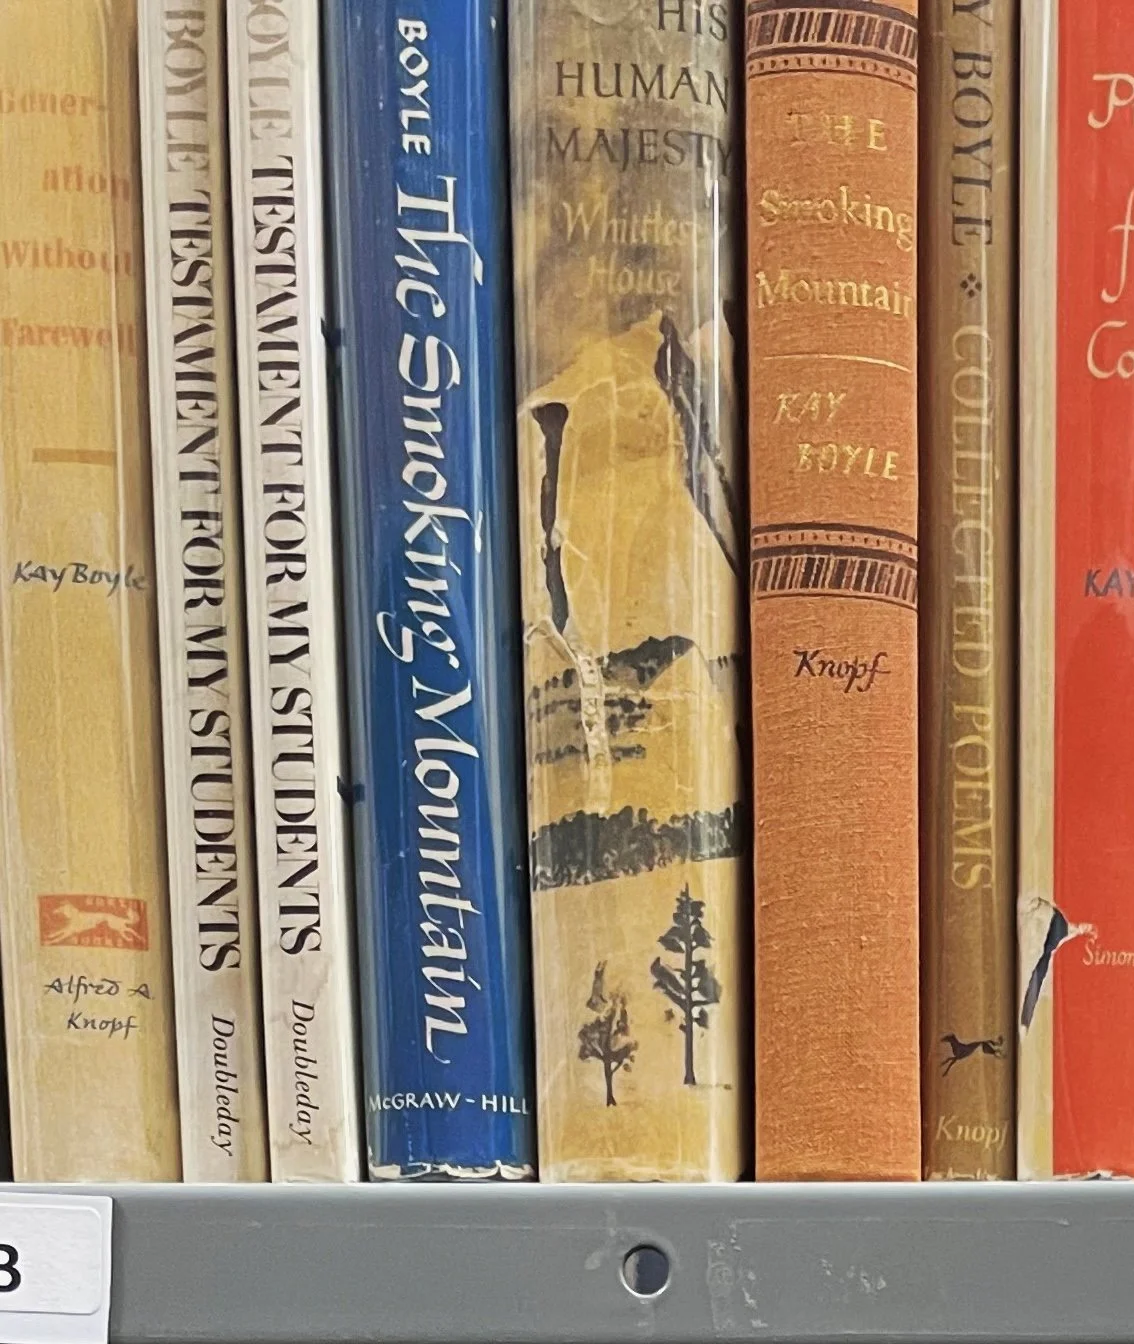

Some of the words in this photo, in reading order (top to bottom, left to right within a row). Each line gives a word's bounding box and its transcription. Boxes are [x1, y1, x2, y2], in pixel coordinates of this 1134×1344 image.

[164, 8, 209, 173] BOYLE
[398, 16, 431, 156] BOYLE
[546, 127, 731, 176] MAJESTY
[556, 61, 729, 113] HUMAN
[951, 50, 994, 248] BOYLE
[396, 175, 484, 318] The
[168, 189, 221, 492] TESTAMENT
[376, 335, 483, 669] Smoking
[796, 442, 899, 482] BOYLE
[951, 325, 994, 677] COLLECTED
[179, 504, 224, 613] FOR
[187, 627, 227, 702] MY
[794, 649, 890, 693] Knopf
[189, 708, 241, 972] STUDENTS
[950, 704, 992, 889] POEMS
[413, 676, 481, 1064] Mountain
[66, 1013, 138, 1037] Knopf
[210, 1013, 238, 1157] Doubleday
[291, 999, 316, 1145] Doubleday
